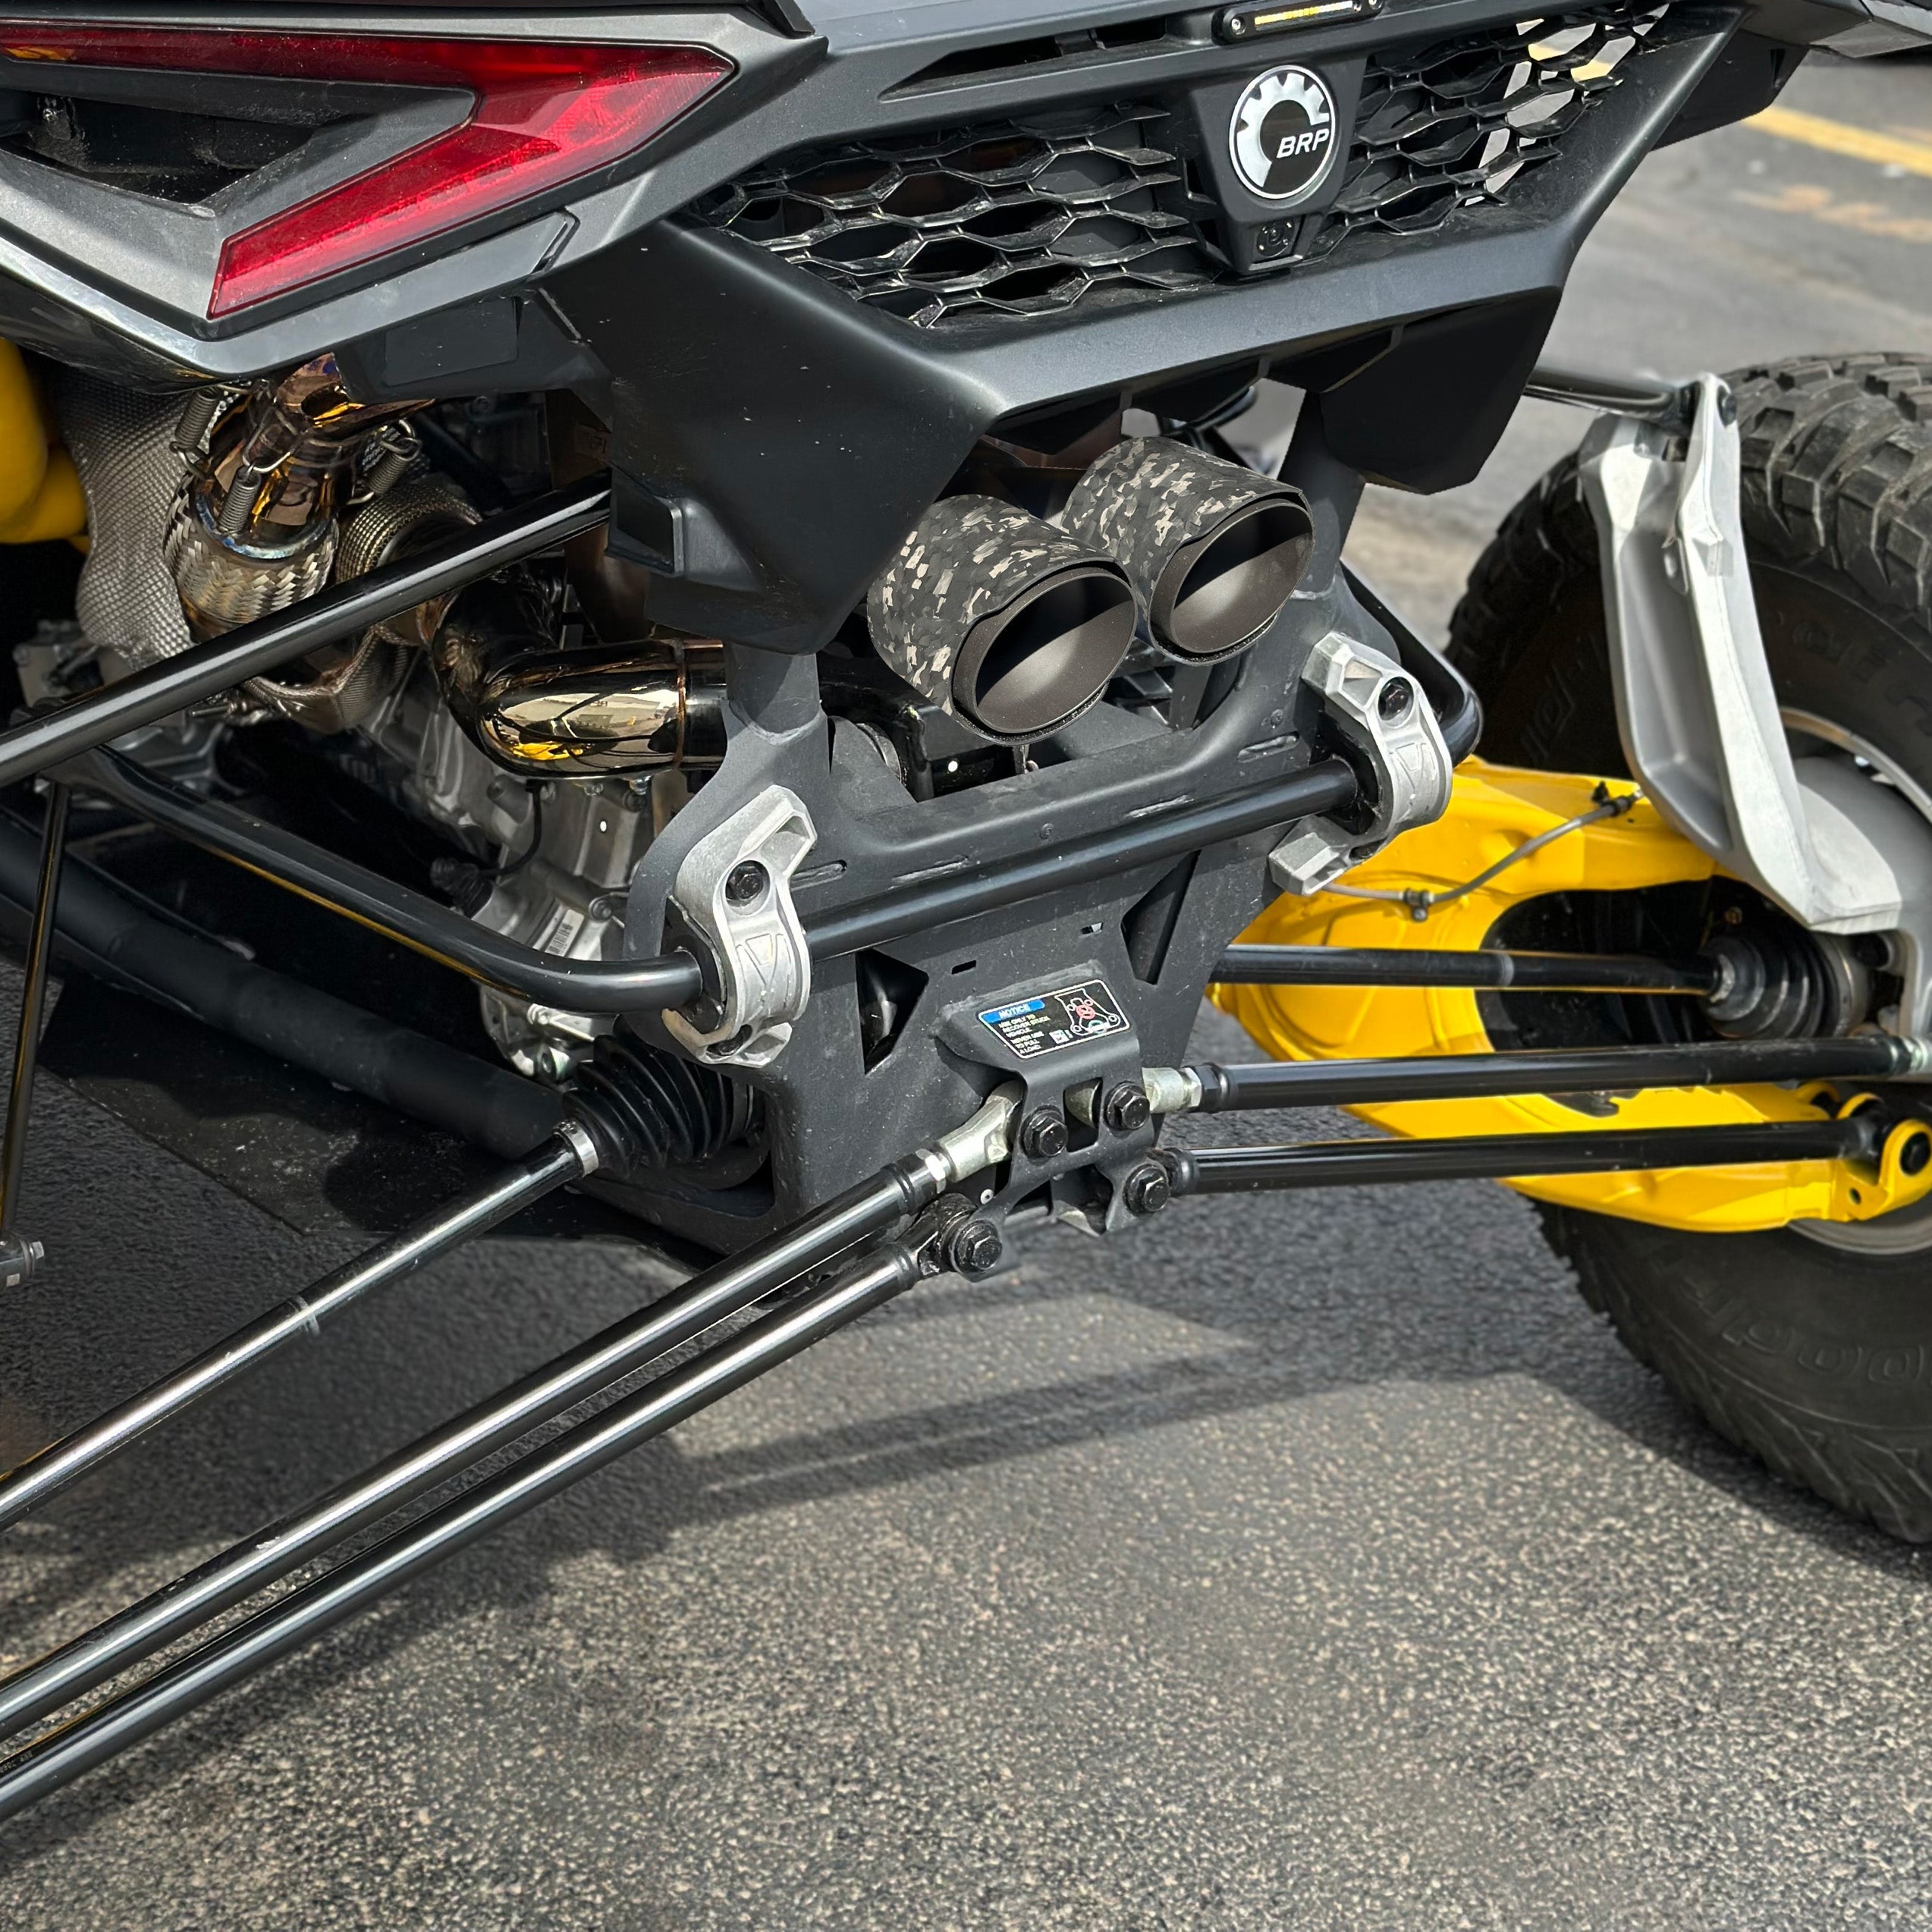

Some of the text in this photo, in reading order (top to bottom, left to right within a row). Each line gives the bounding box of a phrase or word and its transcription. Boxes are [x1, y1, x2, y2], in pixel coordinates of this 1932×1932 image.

[1276, 128, 1330, 159] BRP
[998, 1004, 1031, 1019] NOTICE
[1002, 1021, 1031, 1033] RECOVER
